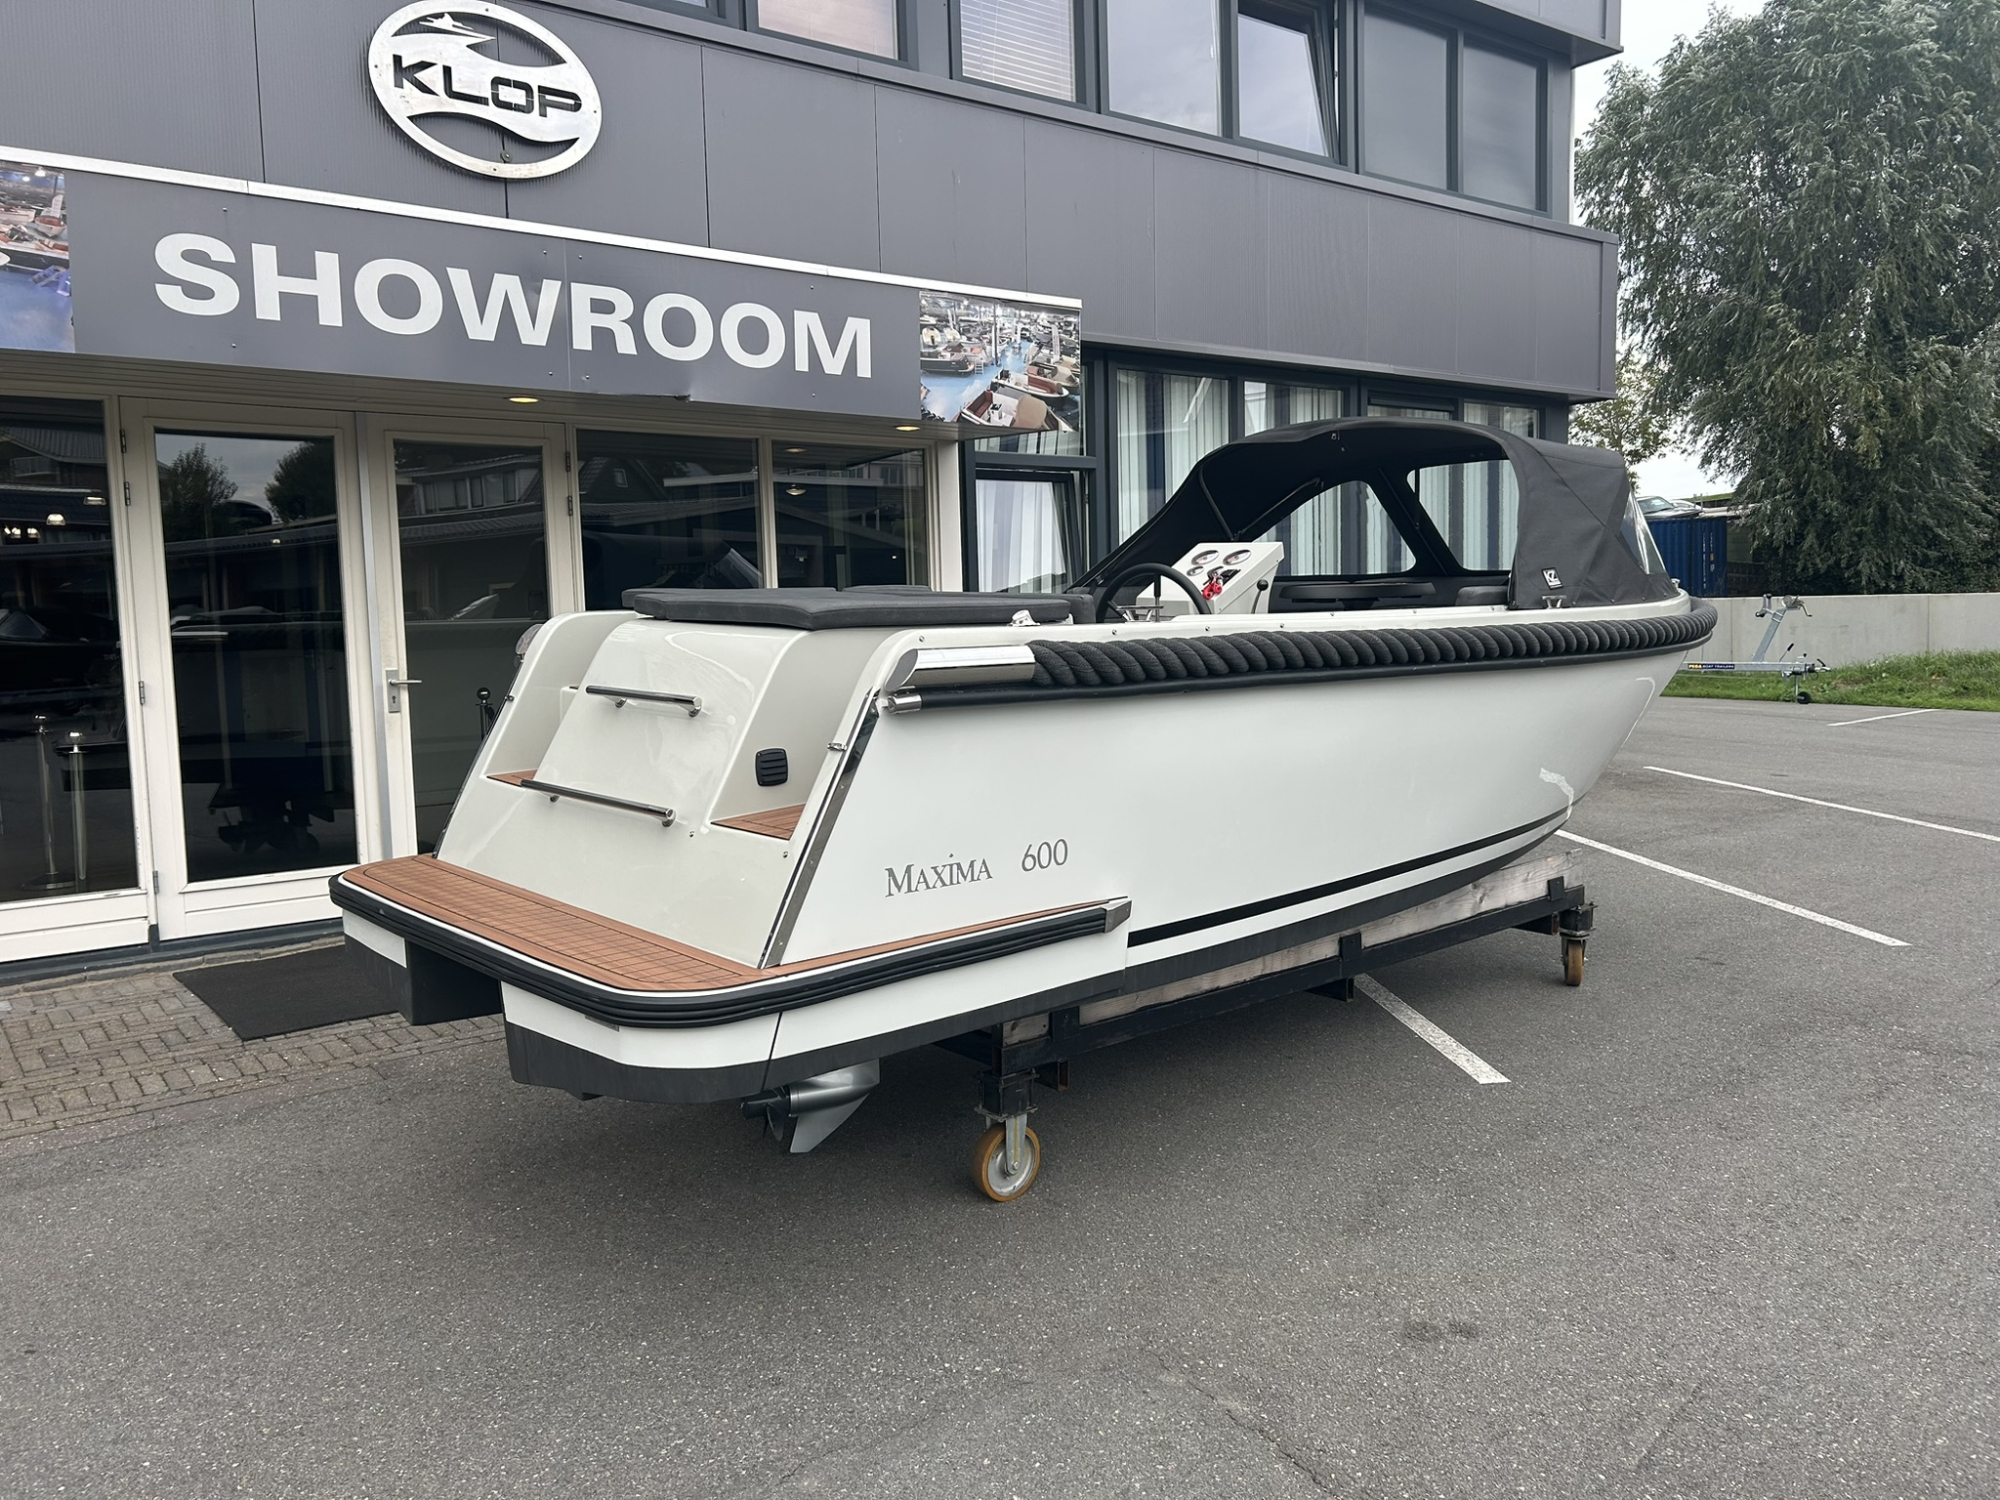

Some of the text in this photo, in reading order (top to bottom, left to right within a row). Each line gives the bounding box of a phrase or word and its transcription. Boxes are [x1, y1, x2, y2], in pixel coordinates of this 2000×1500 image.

[392, 53, 582, 118] KLOP
[154, 233, 873, 379] SHOWROOM
[1021, 838, 1069, 872] 600
